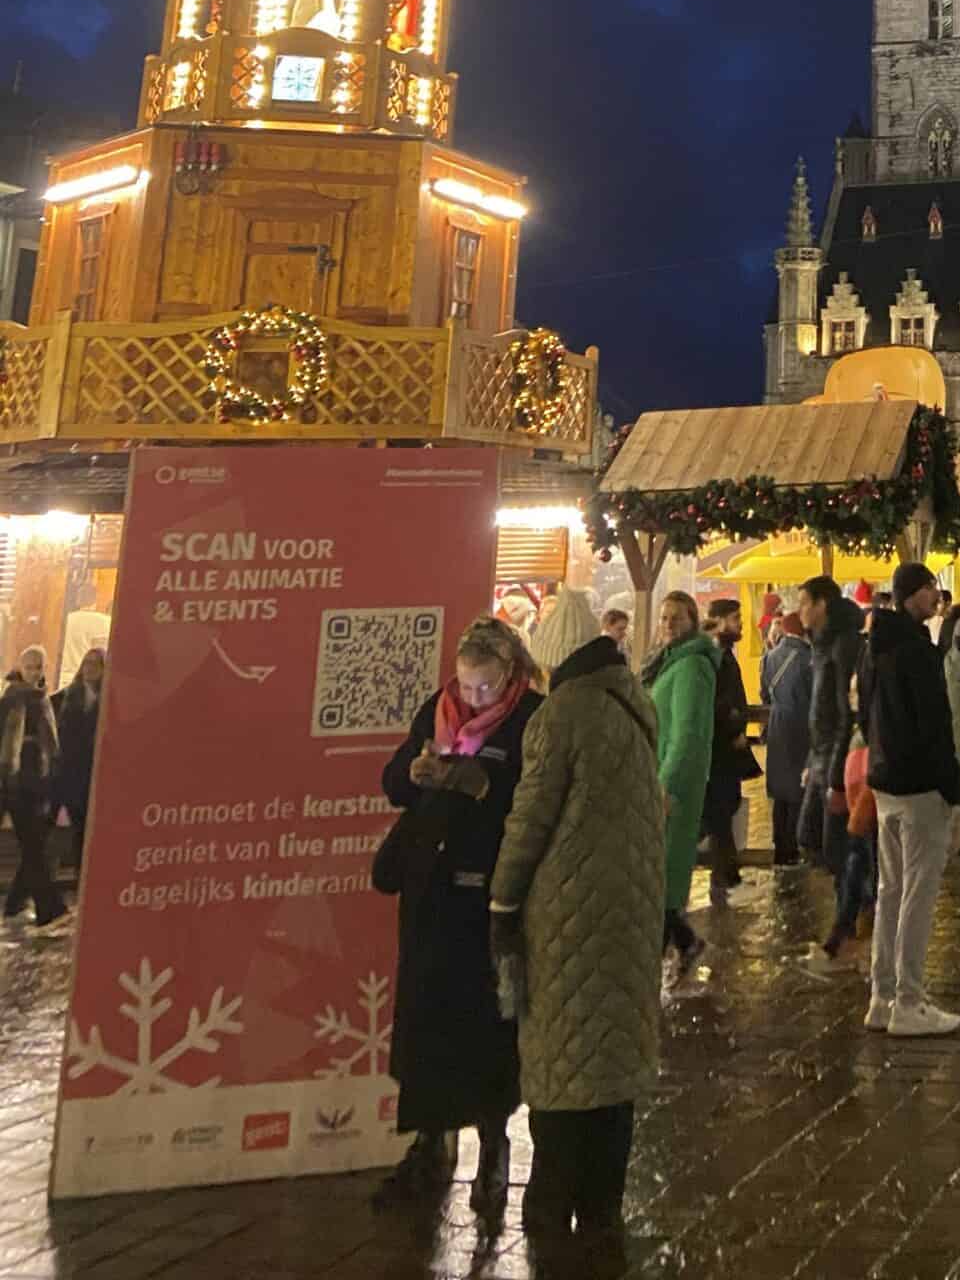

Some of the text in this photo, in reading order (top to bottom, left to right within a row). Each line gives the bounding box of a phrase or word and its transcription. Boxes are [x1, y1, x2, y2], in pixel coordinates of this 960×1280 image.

[159, 531, 335, 562] SCAN VOOR
[155, 567, 344, 592] ALLE ANIMATIE
[153, 598, 279, 622] & EVENTS
[142, 794, 405, 827] Ontmoet de kerstm
[134, 827, 391, 872] geniet van live muz
[118, 870, 374, 911] dagelijks kinderani
